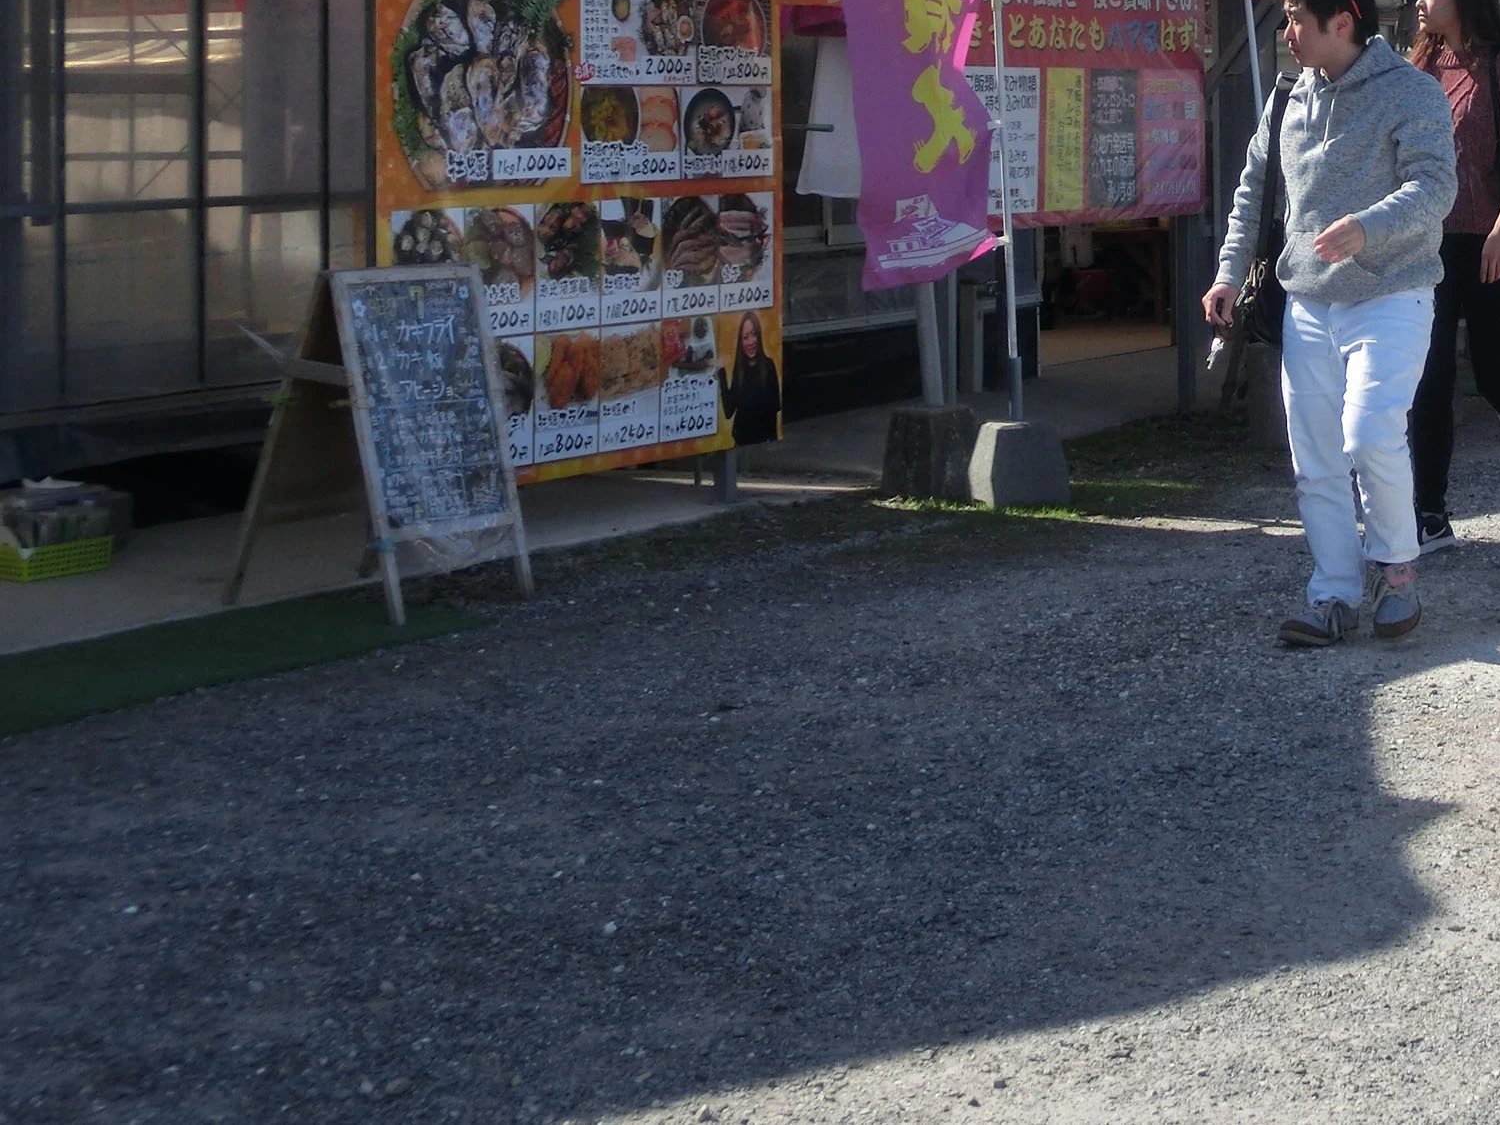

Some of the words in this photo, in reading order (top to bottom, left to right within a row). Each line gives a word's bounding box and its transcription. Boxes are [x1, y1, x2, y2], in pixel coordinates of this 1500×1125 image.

[397, 315, 456, 344] カキフライ
[399, 376, 454, 400] アヒージョ
